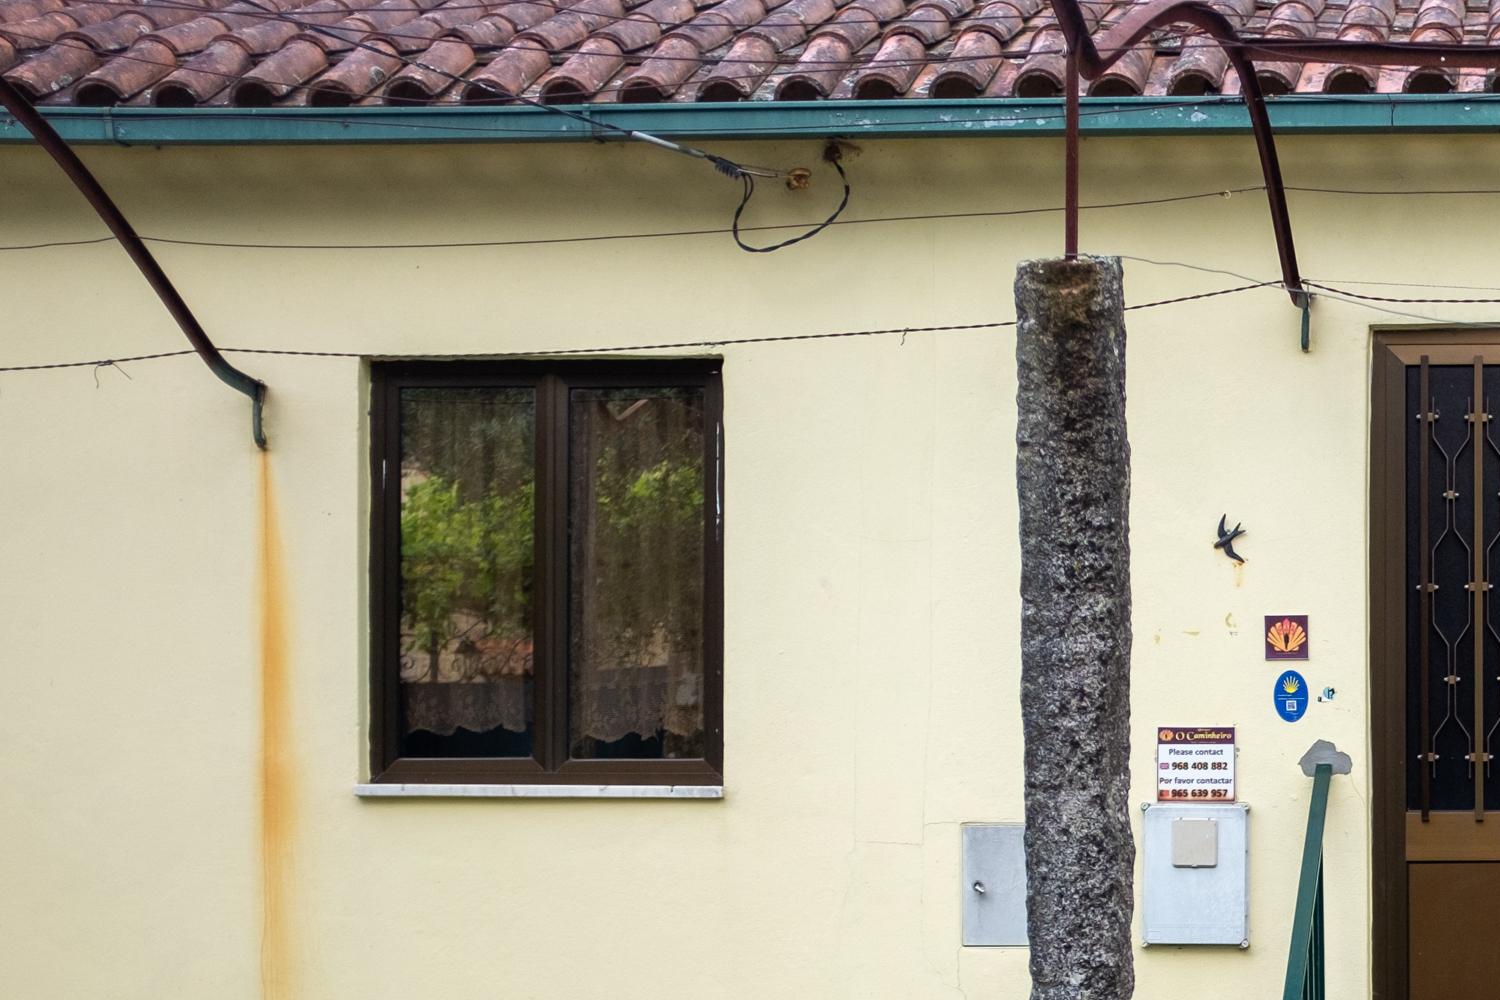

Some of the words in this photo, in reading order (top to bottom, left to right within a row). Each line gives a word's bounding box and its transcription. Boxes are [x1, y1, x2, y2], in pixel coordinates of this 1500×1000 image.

[1175, 731, 1185, 741] O
[1186, 731, 1232, 741] Caminheiro
[1168, 748, 1193, 756] Please
[1195, 748, 1224, 756] contact
[1171, 762, 1189, 770] 968
[1191, 762, 1208, 770] 408
[1211, 762, 1228, 770] 882
[1174, 776, 1194, 784] favor
[1171, 789, 1188, 797] 965
[1191, 789, 1208, 797] 639
[1211, 789, 1228, 797] 957
